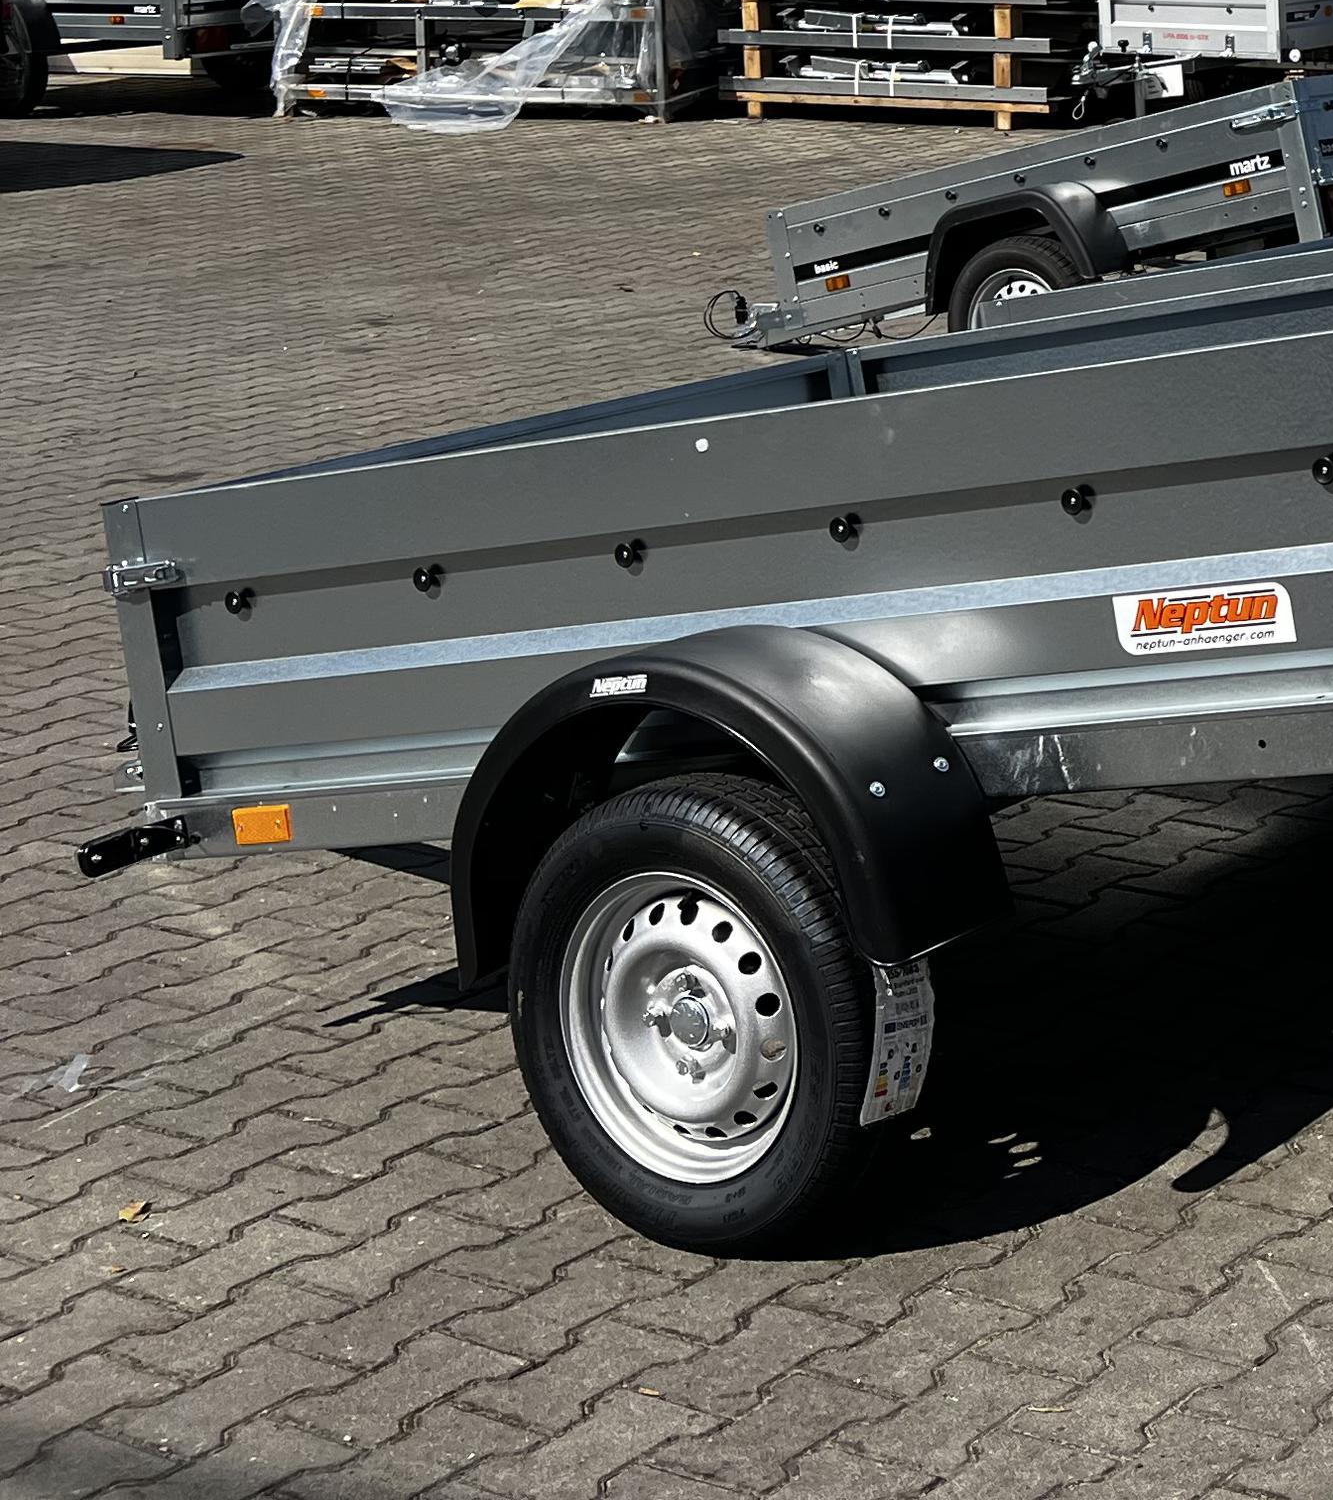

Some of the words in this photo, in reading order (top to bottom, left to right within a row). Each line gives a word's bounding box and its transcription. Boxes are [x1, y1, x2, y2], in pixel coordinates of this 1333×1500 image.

[1229, 153, 1272, 177] martz
[813, 260, 840, 275] basic
[1132, 594, 1279, 635] Neptun
[1136, 629, 1275, 651] neptun-anhaenger.com
[591, 677, 648, 696] Neptun
